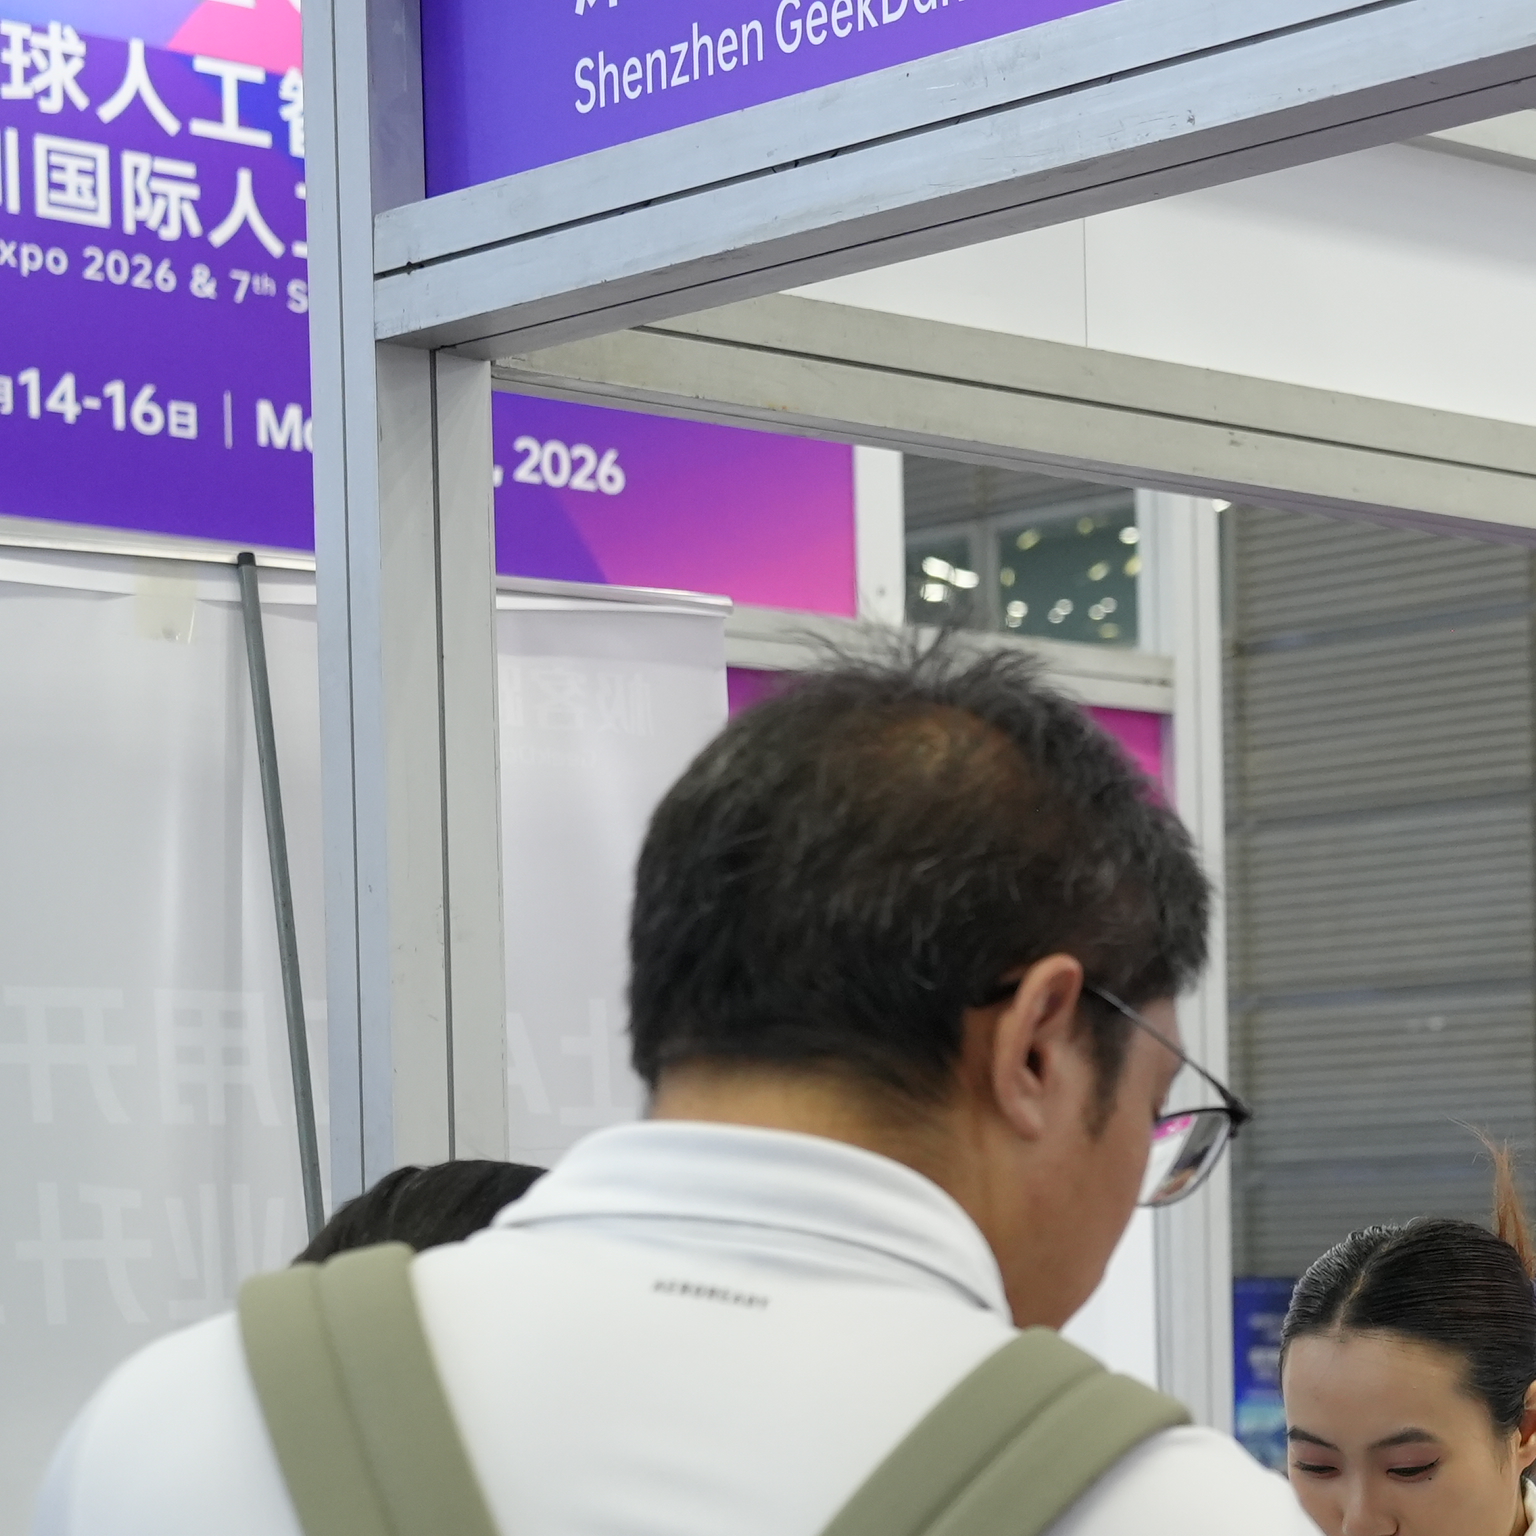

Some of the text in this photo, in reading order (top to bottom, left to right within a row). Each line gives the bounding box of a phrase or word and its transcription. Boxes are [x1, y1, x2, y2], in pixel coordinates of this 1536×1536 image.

[574, 18, 764, 115] Shenzhen
[4, 126, 308, 259] 国际人
[82, 245, 178, 292] 2026
[189, 262, 218, 300] &
[513, 436, 627, 498] 2026
